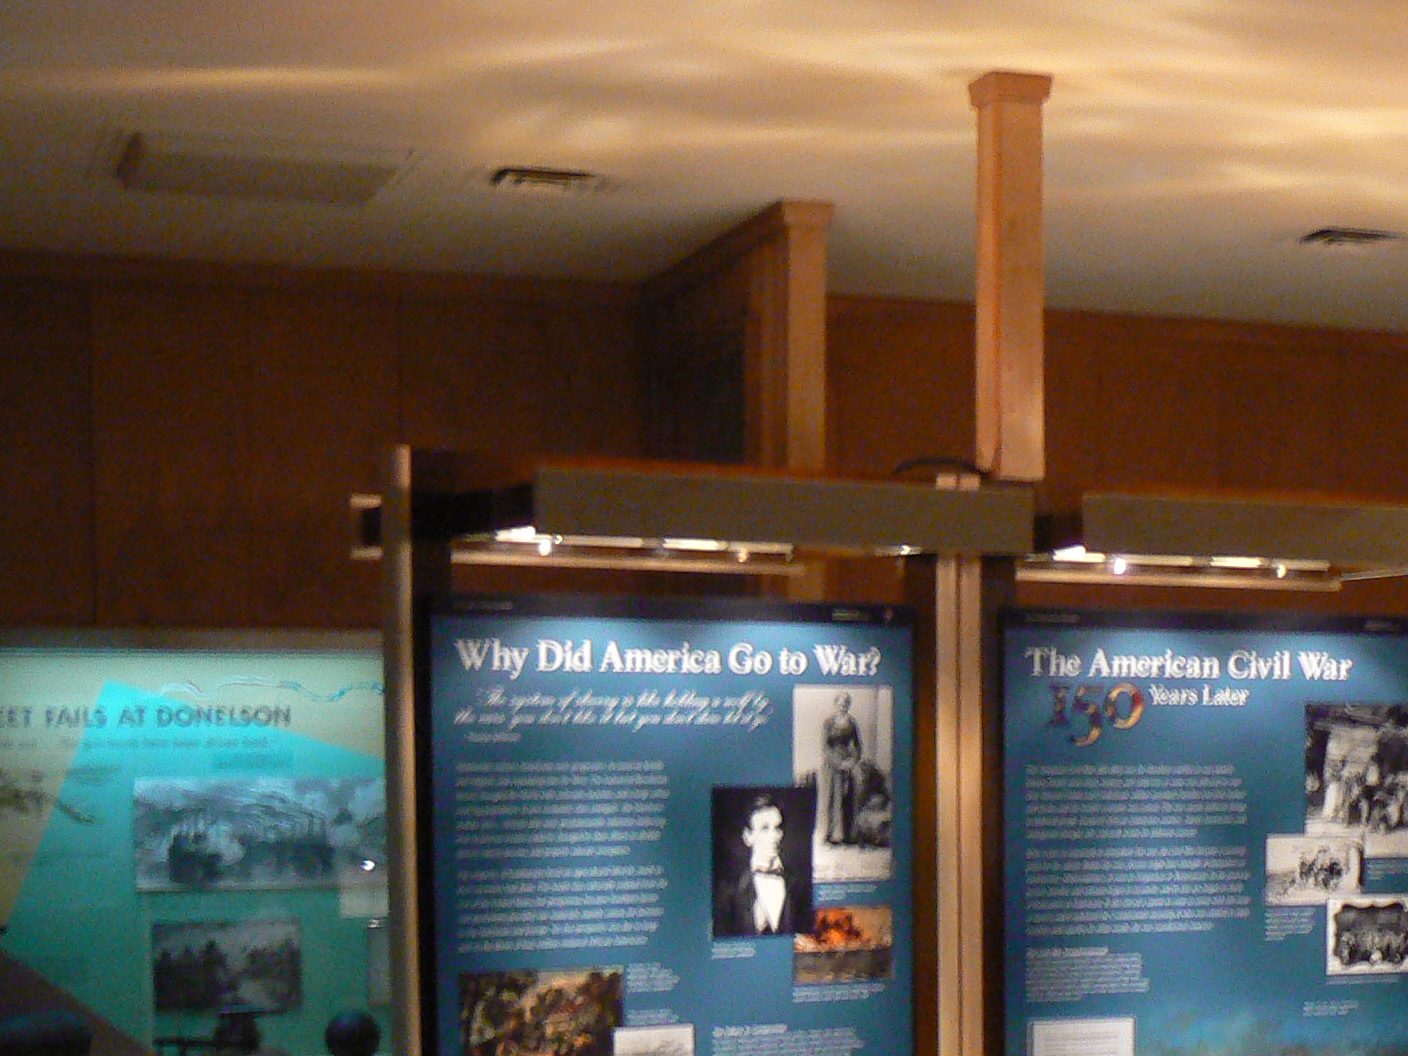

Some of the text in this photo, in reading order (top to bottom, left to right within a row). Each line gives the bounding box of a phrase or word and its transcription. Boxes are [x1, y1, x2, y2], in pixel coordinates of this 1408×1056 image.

[454, 639, 882, 679] Why Did America Go to War?
[1025, 647, 1354, 680] The American Civil War
[117, 706, 146, 727] AT
[156, 705, 292, 727] DONELSON
[1046, 682, 1250, 746] 150 Years Later
